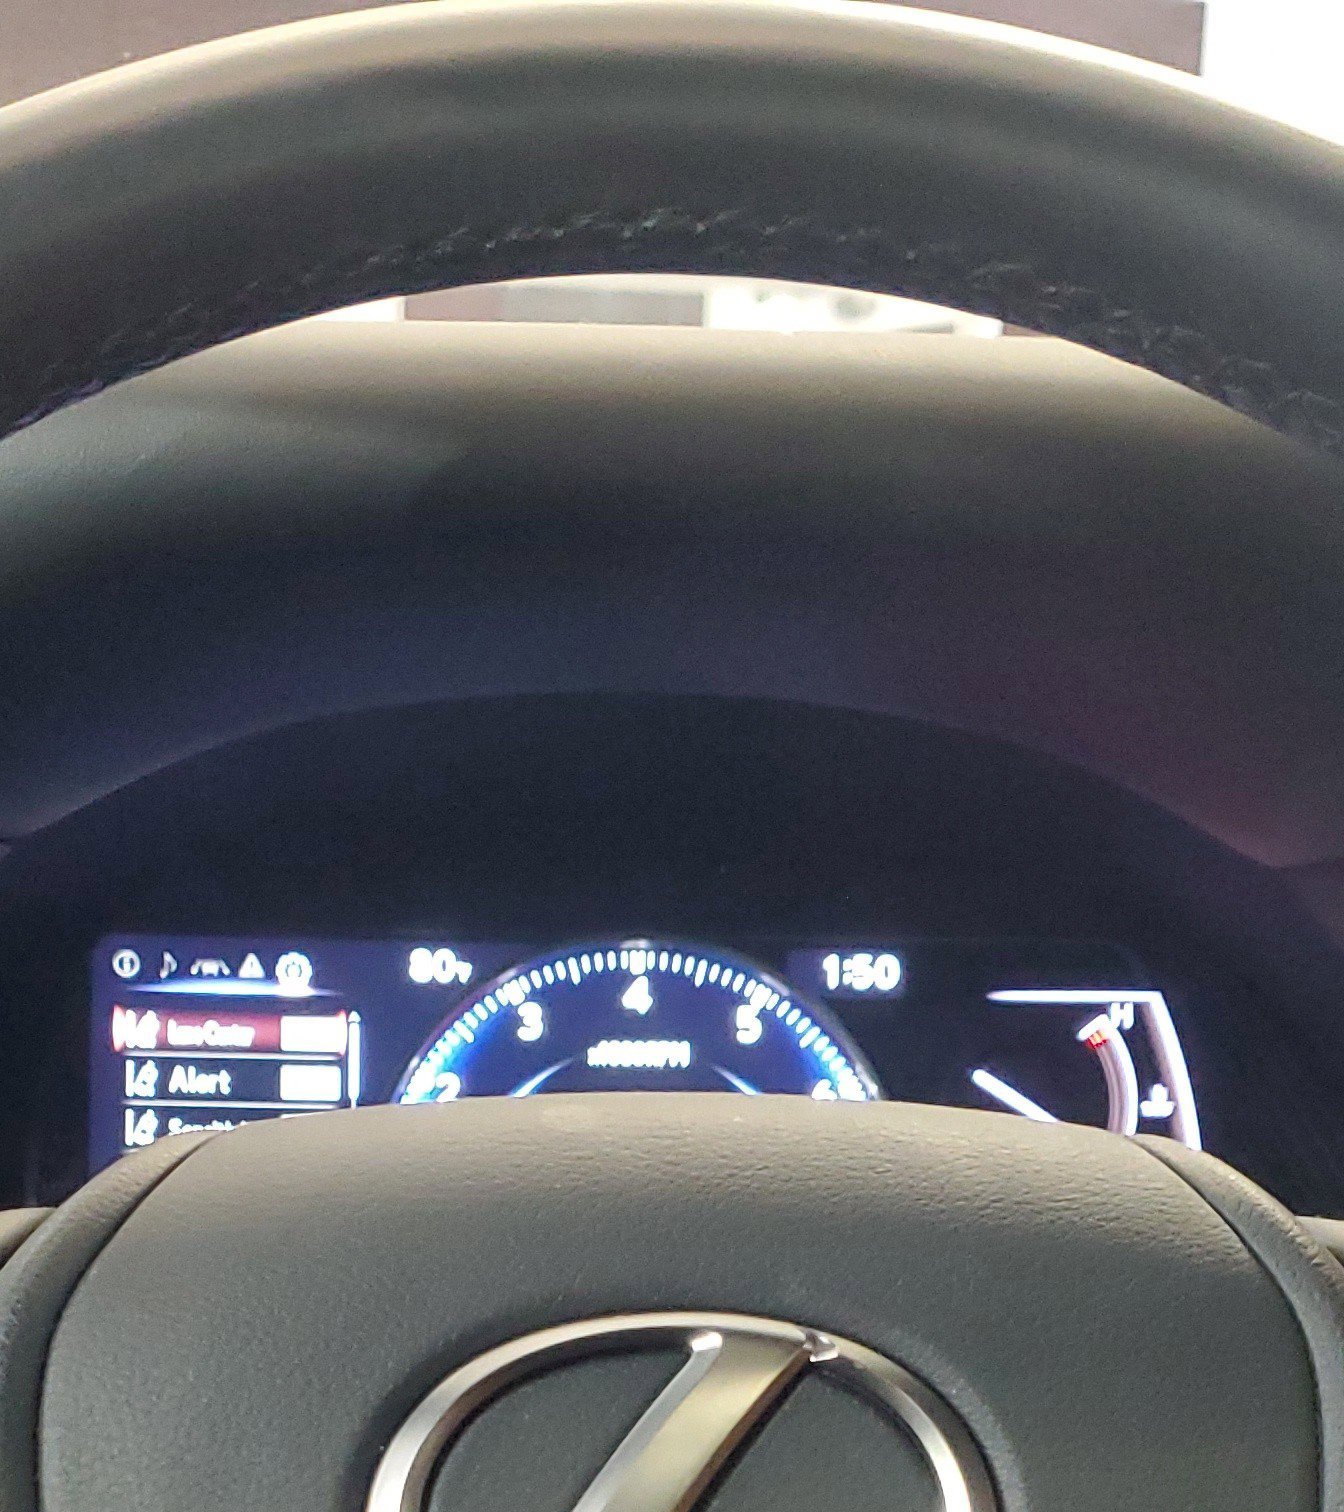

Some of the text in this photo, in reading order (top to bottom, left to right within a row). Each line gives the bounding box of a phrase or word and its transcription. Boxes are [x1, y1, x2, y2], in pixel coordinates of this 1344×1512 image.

[822, 953, 901, 991] 1:50
[621, 975, 654, 1015] 4
[517, 1001, 544, 1042] 3
[736, 1004, 763, 1045] 5
[168, 1064, 232, 1095] Alert
[435, 1071, 461, 1102] 2
